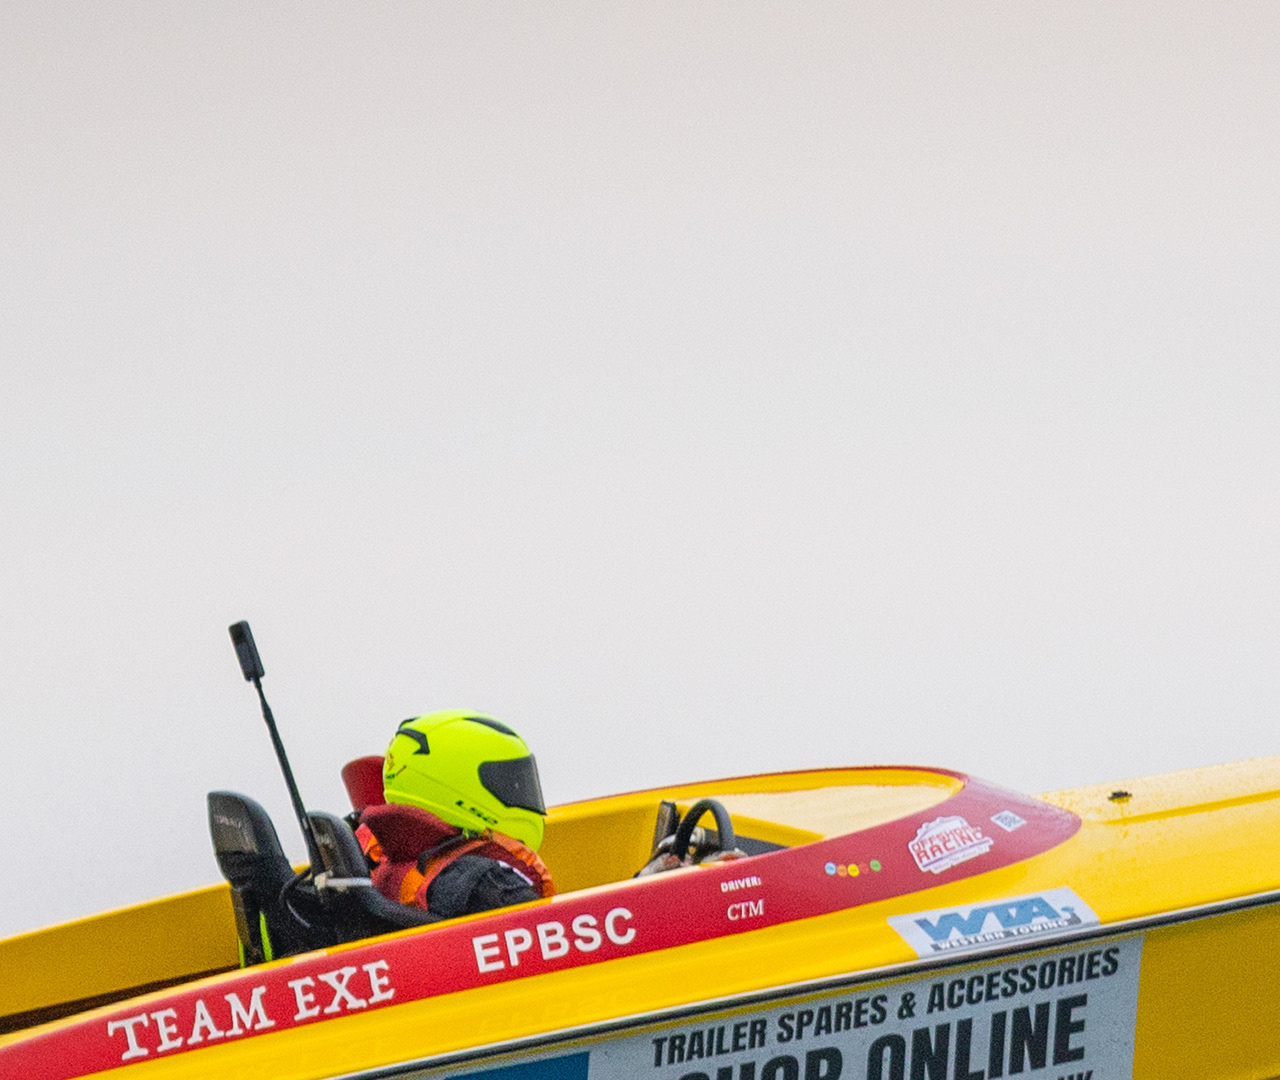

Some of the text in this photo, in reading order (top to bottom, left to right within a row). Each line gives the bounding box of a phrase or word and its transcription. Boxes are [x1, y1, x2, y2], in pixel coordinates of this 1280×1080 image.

[472, 907, 637, 975] EPBSC
[727, 898, 764, 921] CTM
[937, 919, 1070, 950] WESTERN TOWING
[107, 959, 396, 1062] TEAM EXE
[652, 947, 1120, 1068] TRAILER SPARES & ACCESSORIES
